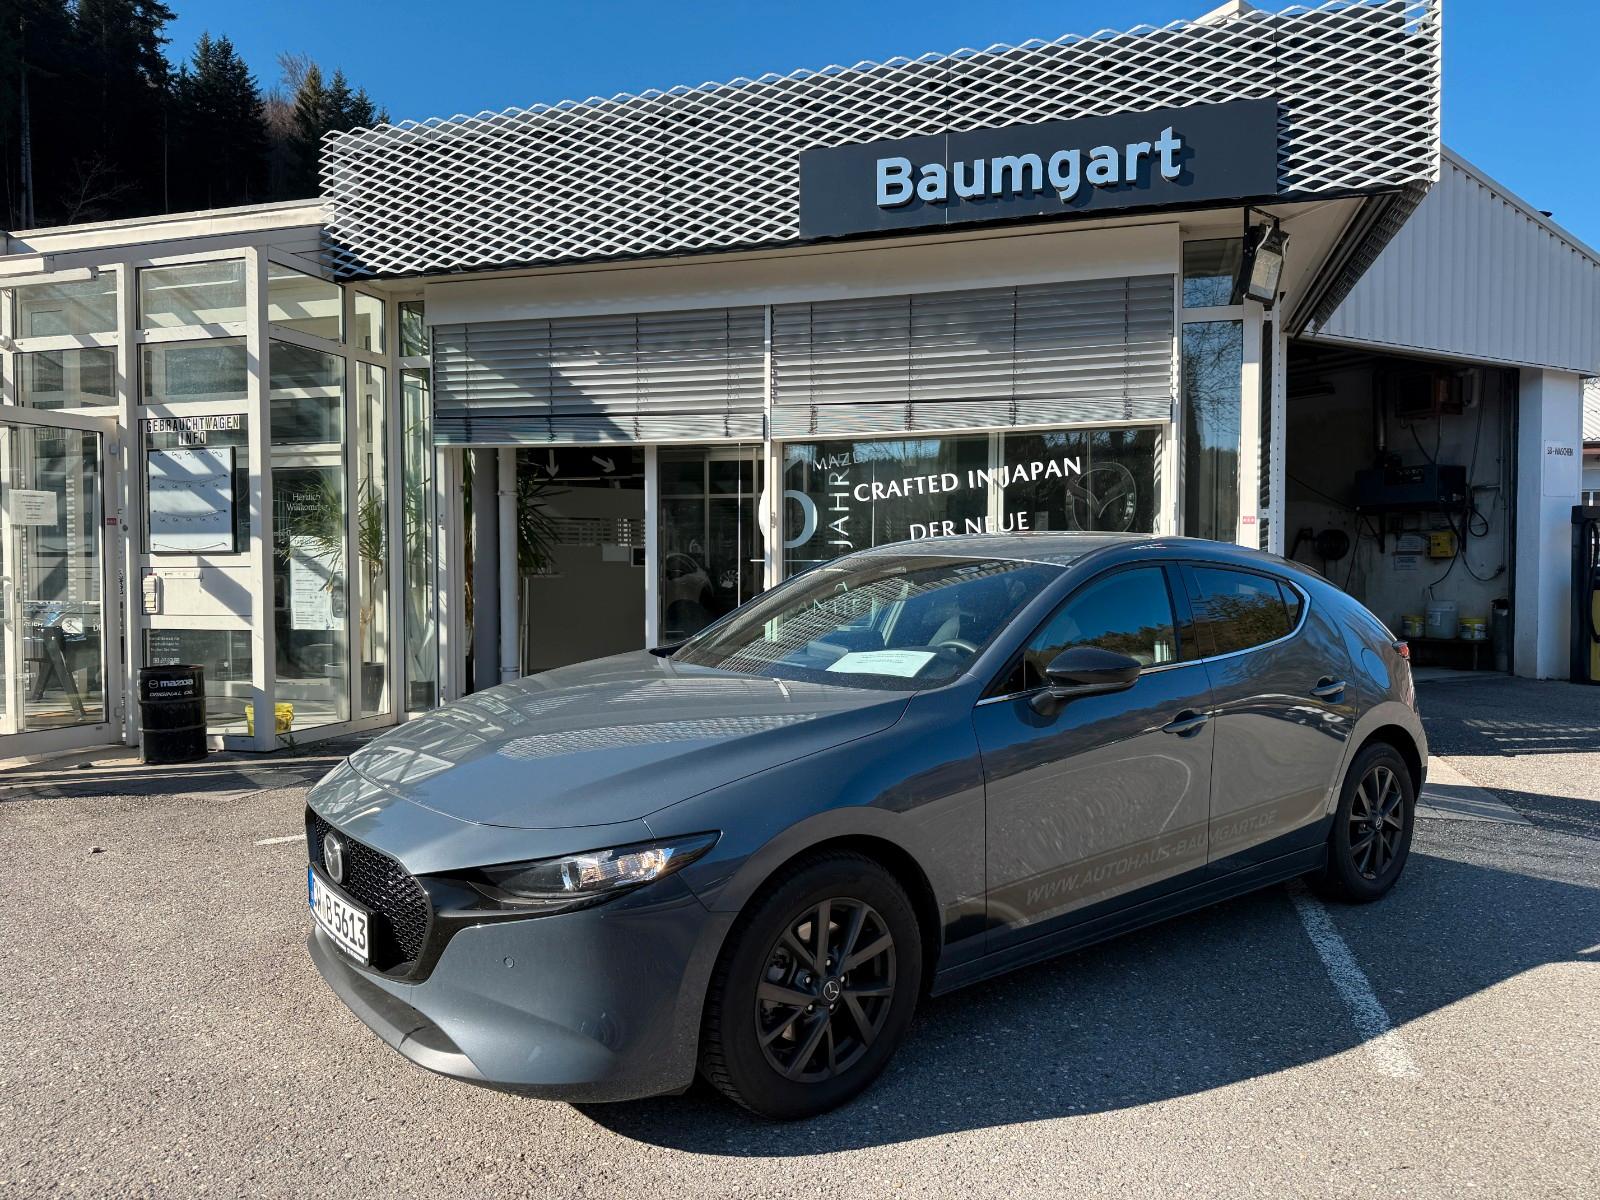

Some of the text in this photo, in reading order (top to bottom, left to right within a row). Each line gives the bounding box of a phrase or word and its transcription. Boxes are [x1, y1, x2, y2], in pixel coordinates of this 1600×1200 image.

[876, 125, 1183, 207] Baumgart
[146, 415, 239, 433] GEBRAUCHTWAGEN
[180, 432, 206, 445] INFO
[853, 456, 1081, 502] CRAFTED IN JAPAN
[909, 511, 1030, 542] DER NEUE
